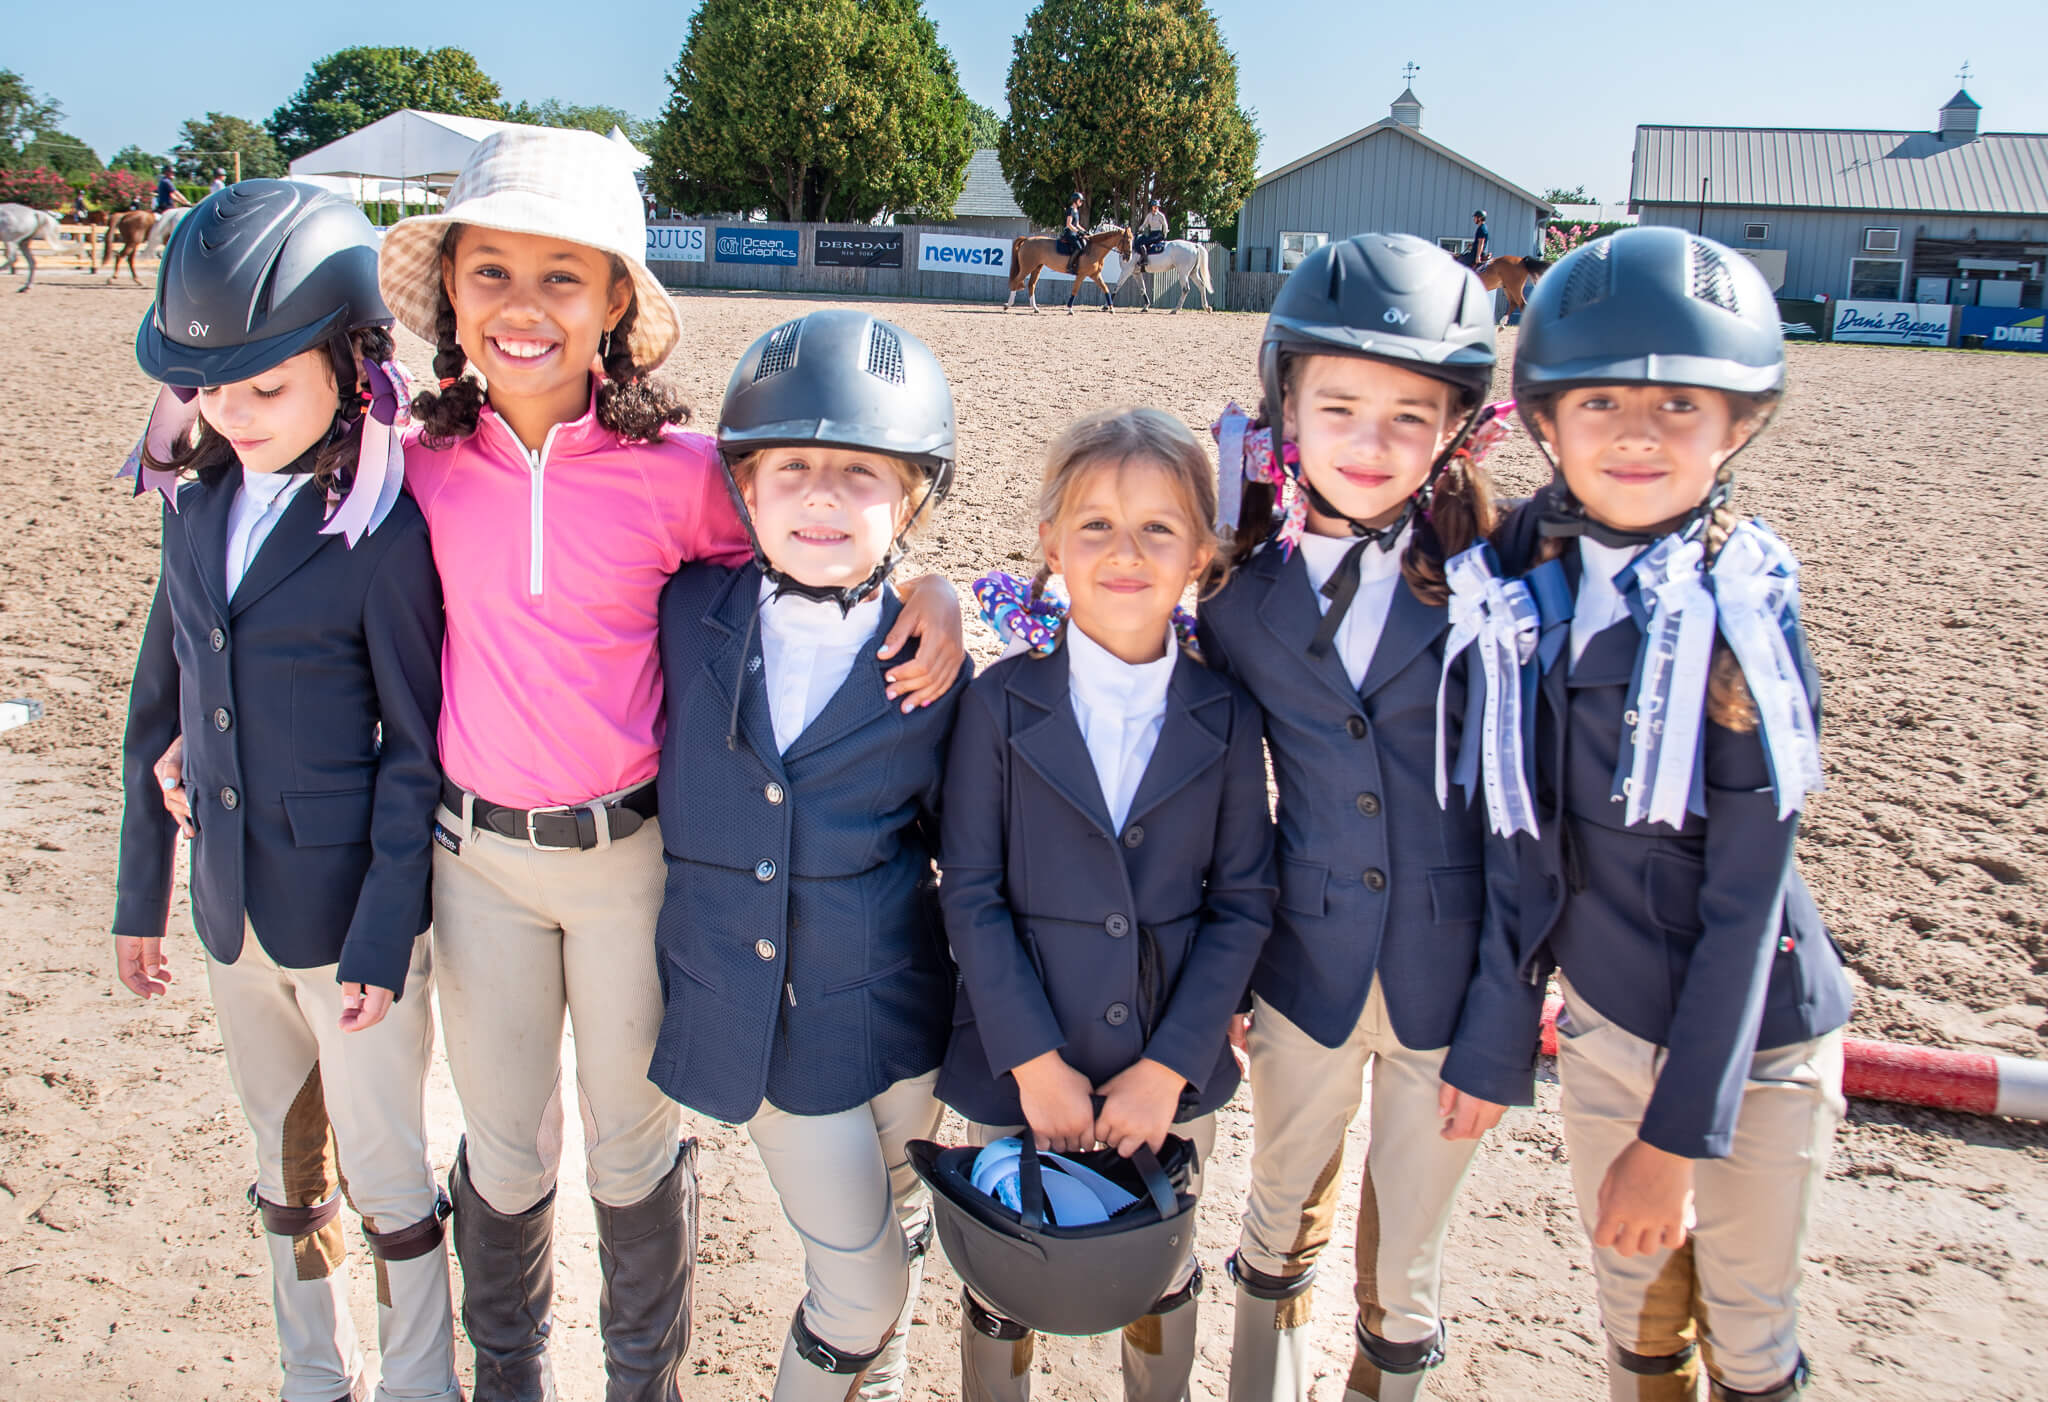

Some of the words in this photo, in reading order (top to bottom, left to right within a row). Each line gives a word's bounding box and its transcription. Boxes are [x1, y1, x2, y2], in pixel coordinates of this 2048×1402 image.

[646, 229, 702, 249] QUUS
[743, 237, 784, 248] Ocean
[743, 246, 797, 258] Graphics
[925, 245, 1004, 266] news12
[1836, 308, 1885, 330] Dan's
[1888, 312, 1952, 338] Papers
[1992, 326, 2044, 342] DIME
